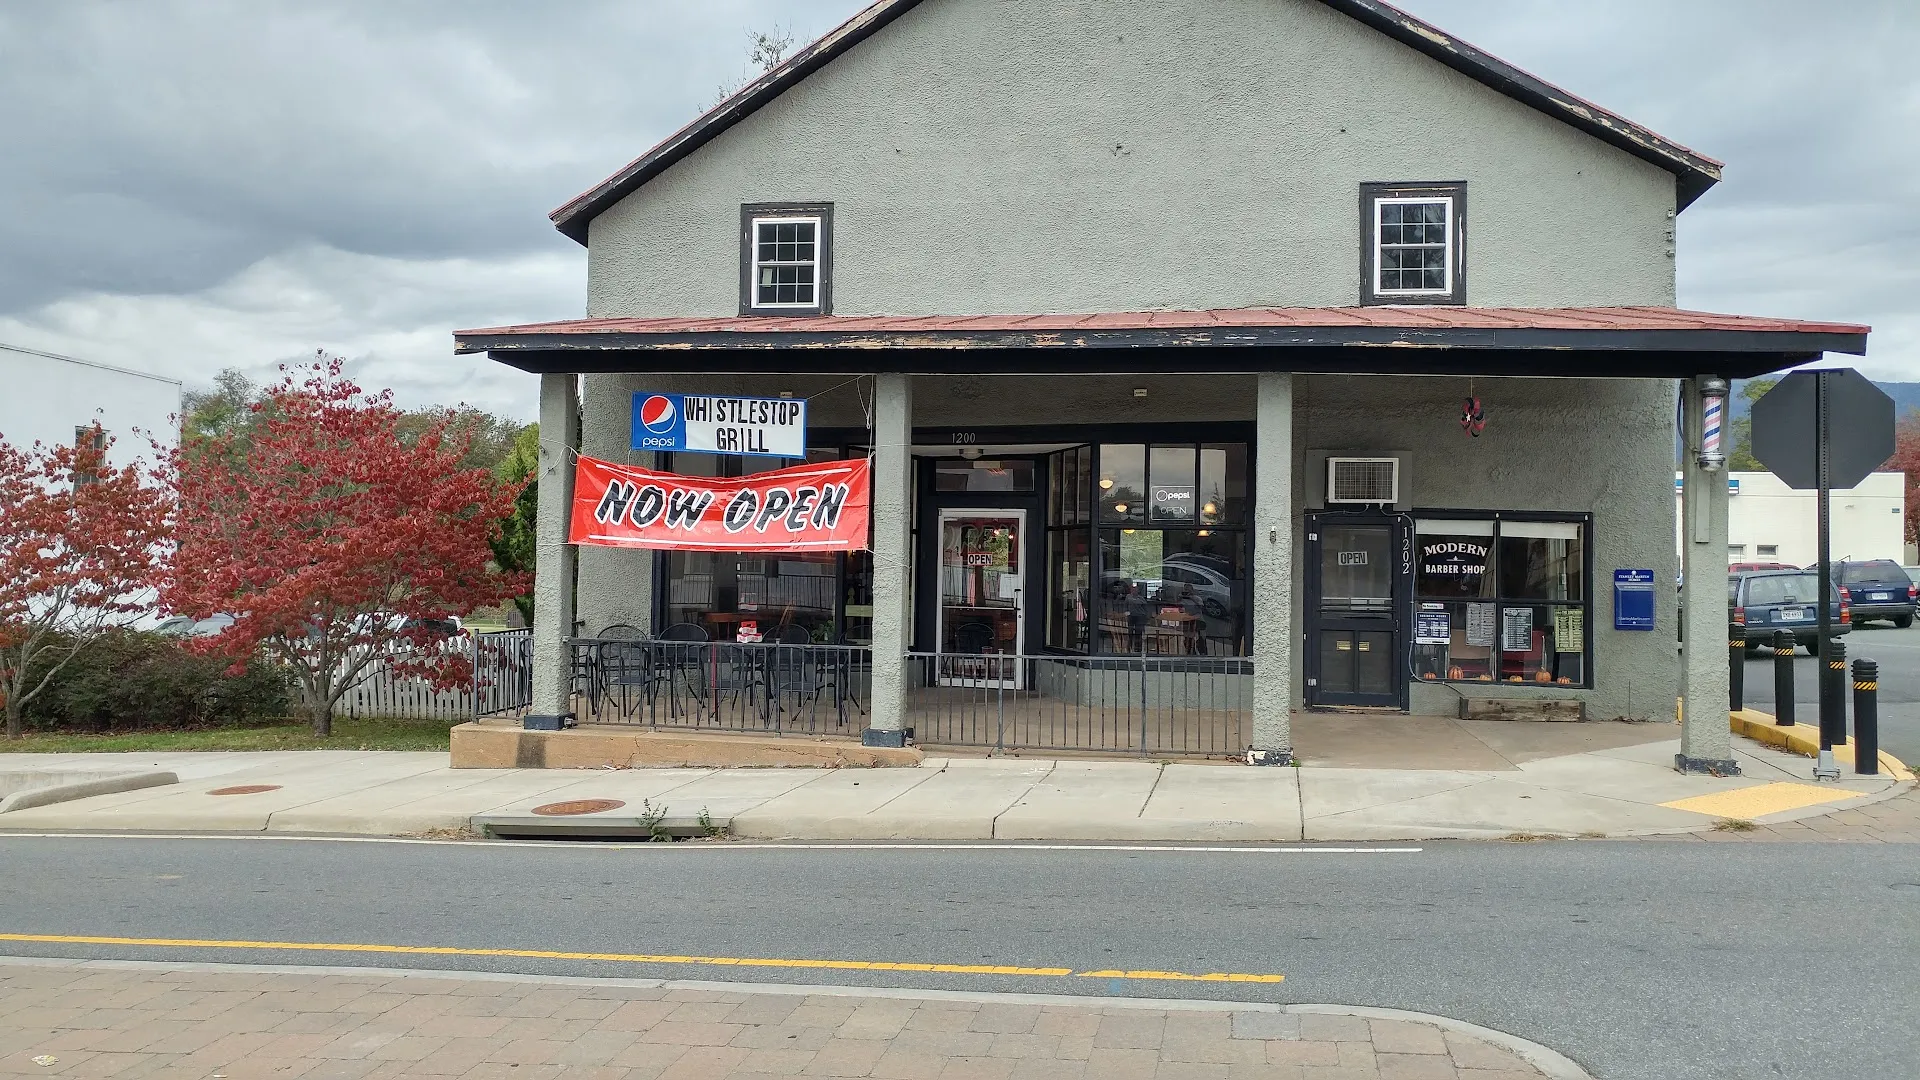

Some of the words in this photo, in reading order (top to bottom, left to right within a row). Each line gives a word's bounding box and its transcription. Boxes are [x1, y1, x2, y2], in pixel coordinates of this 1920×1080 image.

[642, 436, 675, 448] pepsi
[716, 427, 769, 453] GRILL
[951, 432, 976, 444] 1200
[1167, 491, 1191, 501] pepsi
[594, 478, 715, 530] NOW
[722, 482, 850, 534] OPEN
[1160, 506, 1187, 515] OPEN
[1402, 526, 1410, 575] 1202
[1423, 542, 1488, 557] MODERN
[968, 554, 992, 565] OPEN
[1340, 552, 1366, 565] OPEN
[1425, 564, 1459, 574] BARBER
[1461, 564, 1486, 575] SHOP
